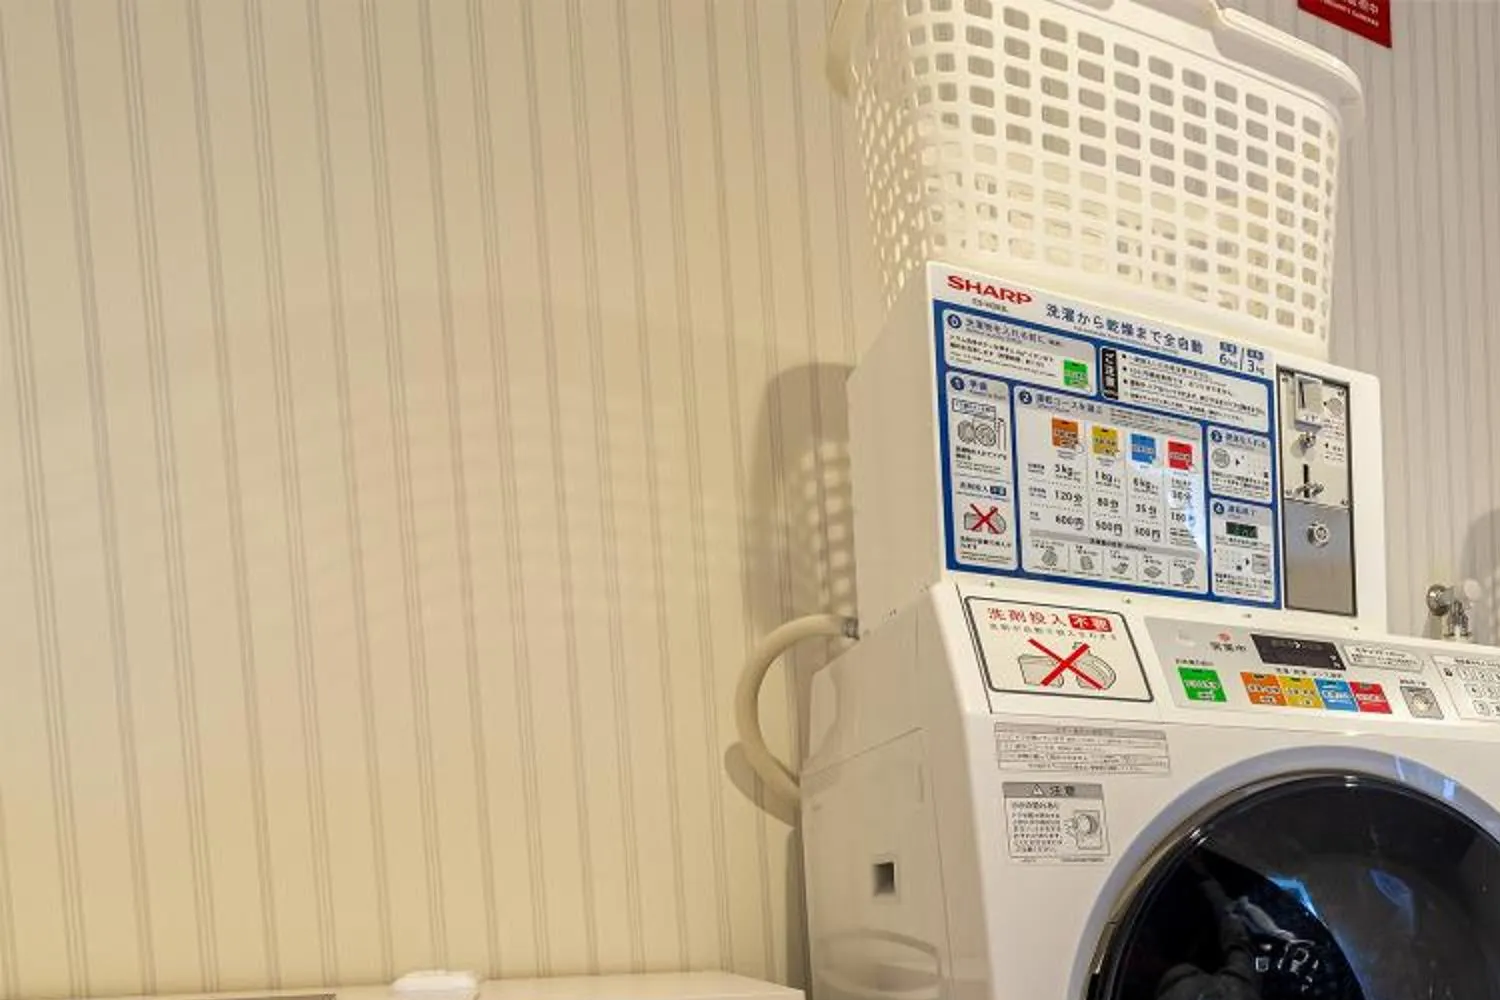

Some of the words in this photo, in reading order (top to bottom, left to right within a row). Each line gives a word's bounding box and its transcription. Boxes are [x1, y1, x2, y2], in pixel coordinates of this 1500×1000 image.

[947, 275, 1032, 304] SHARP
[1046, 303, 1203, 354] 洗濯から乾燥まで全自動
[987, 607, 1066, 626] 洗剤投入
